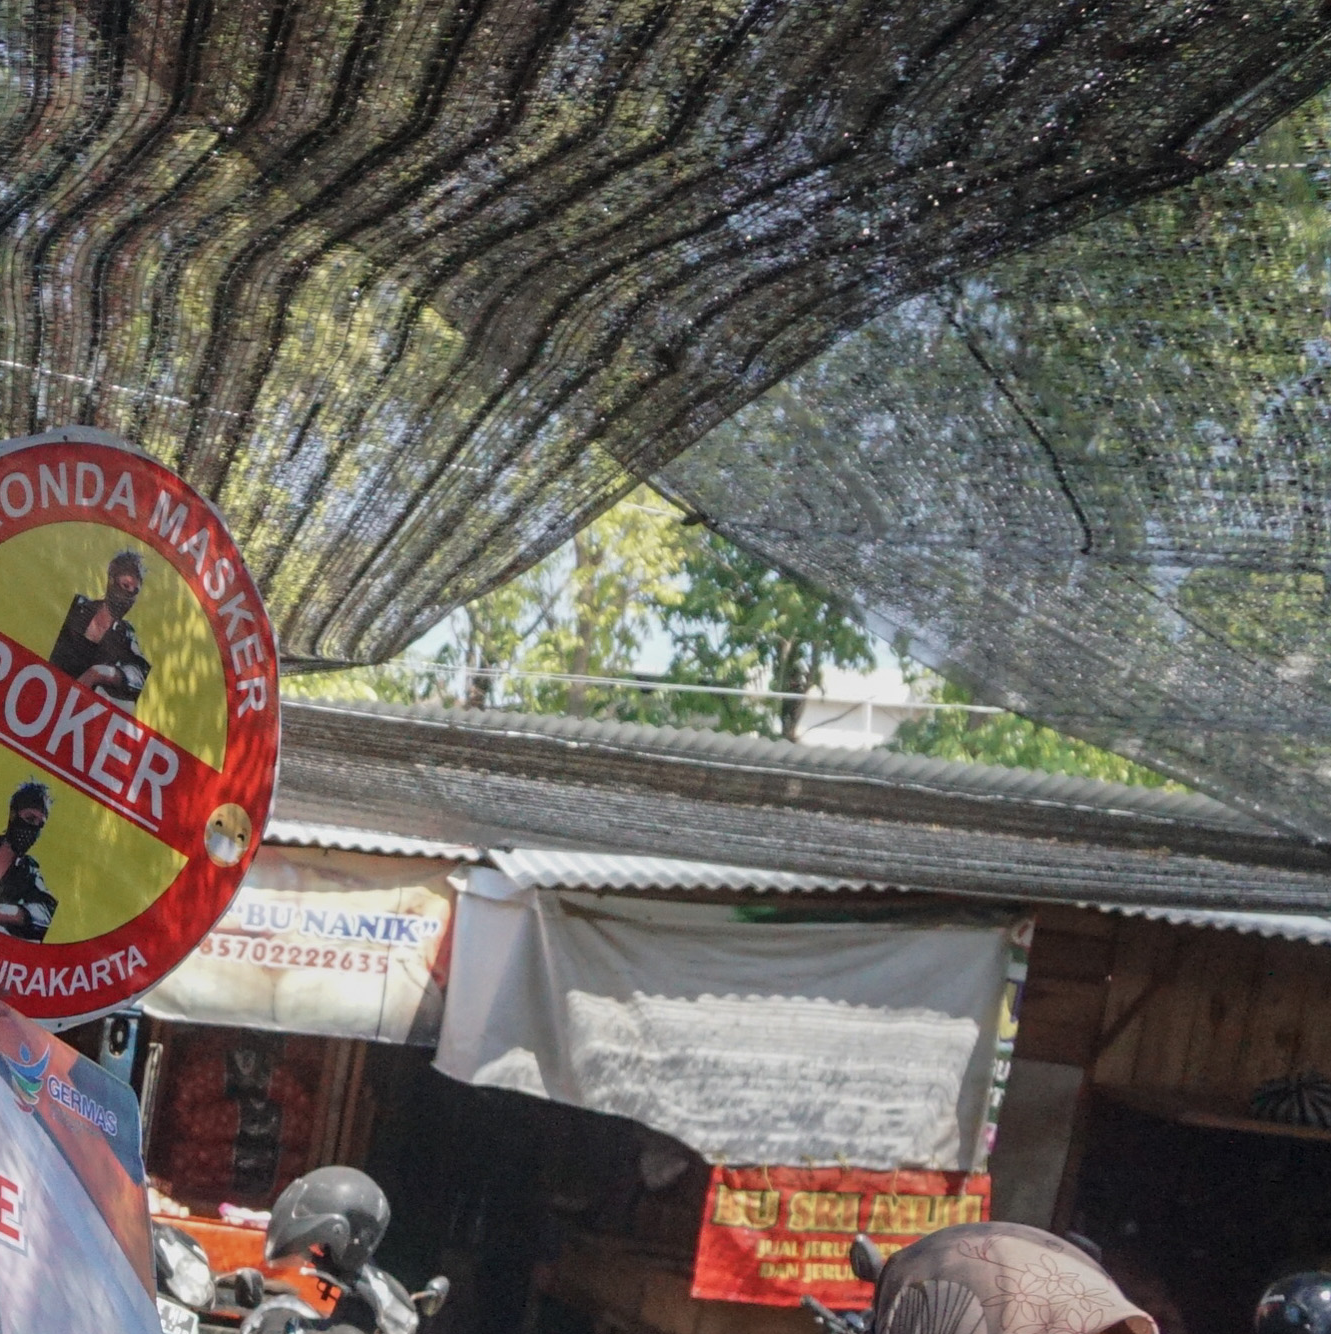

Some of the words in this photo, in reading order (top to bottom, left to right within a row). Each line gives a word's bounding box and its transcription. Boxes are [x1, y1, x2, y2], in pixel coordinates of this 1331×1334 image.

[148, 489, 267, 719] MASKER
[47, 1075, 118, 1137] GERMAS
[713, 1184, 780, 1230] BU
[789, 1191, 861, 1232] SRI
[760, 1262, 800, 1279] DAN
[803, 1241, 852, 1259] JERU
